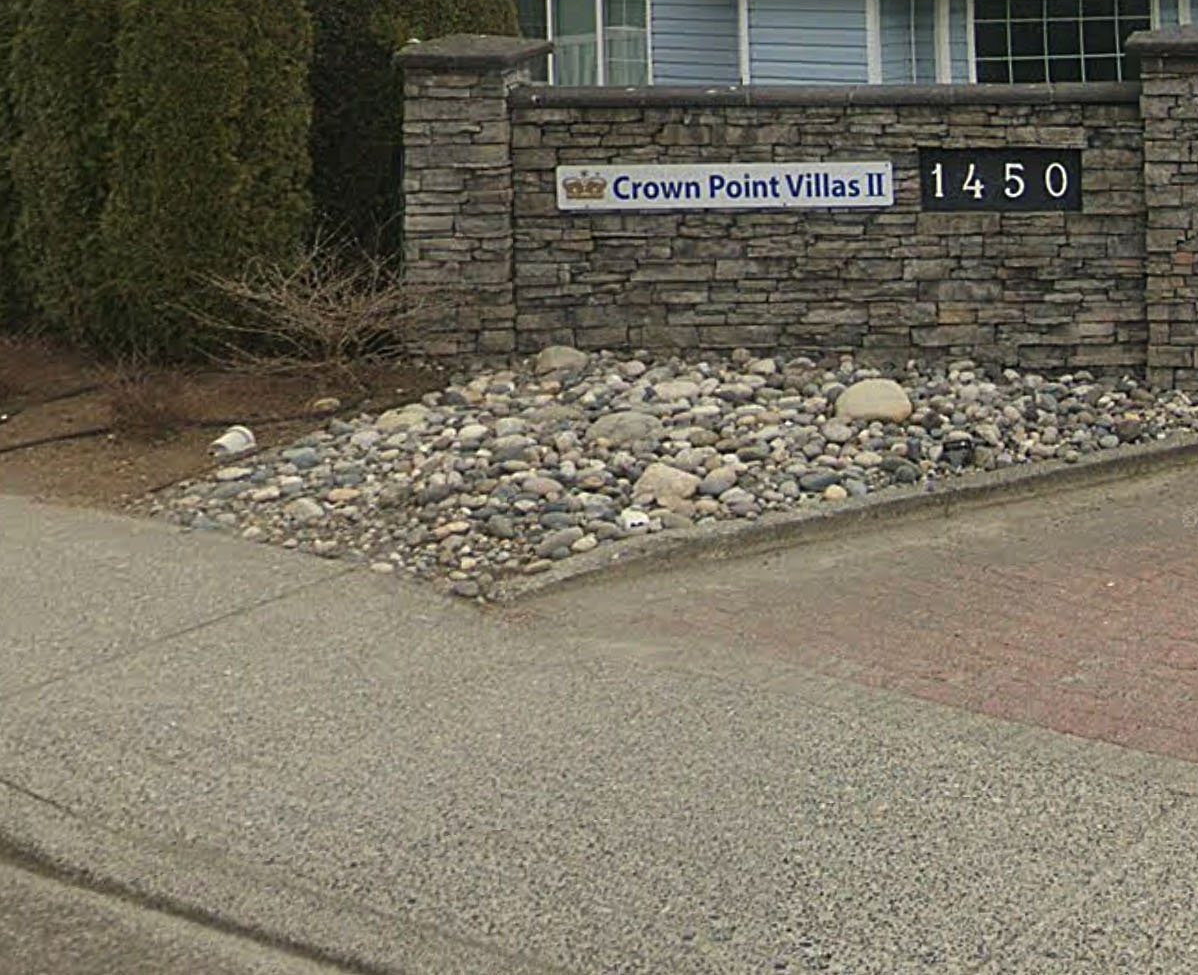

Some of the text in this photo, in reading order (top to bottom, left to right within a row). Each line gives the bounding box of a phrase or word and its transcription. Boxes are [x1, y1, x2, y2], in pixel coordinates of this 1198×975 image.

[613, 172, 886, 200] Crown Point Villas II
[931, 162, 1068, 200] 1450
